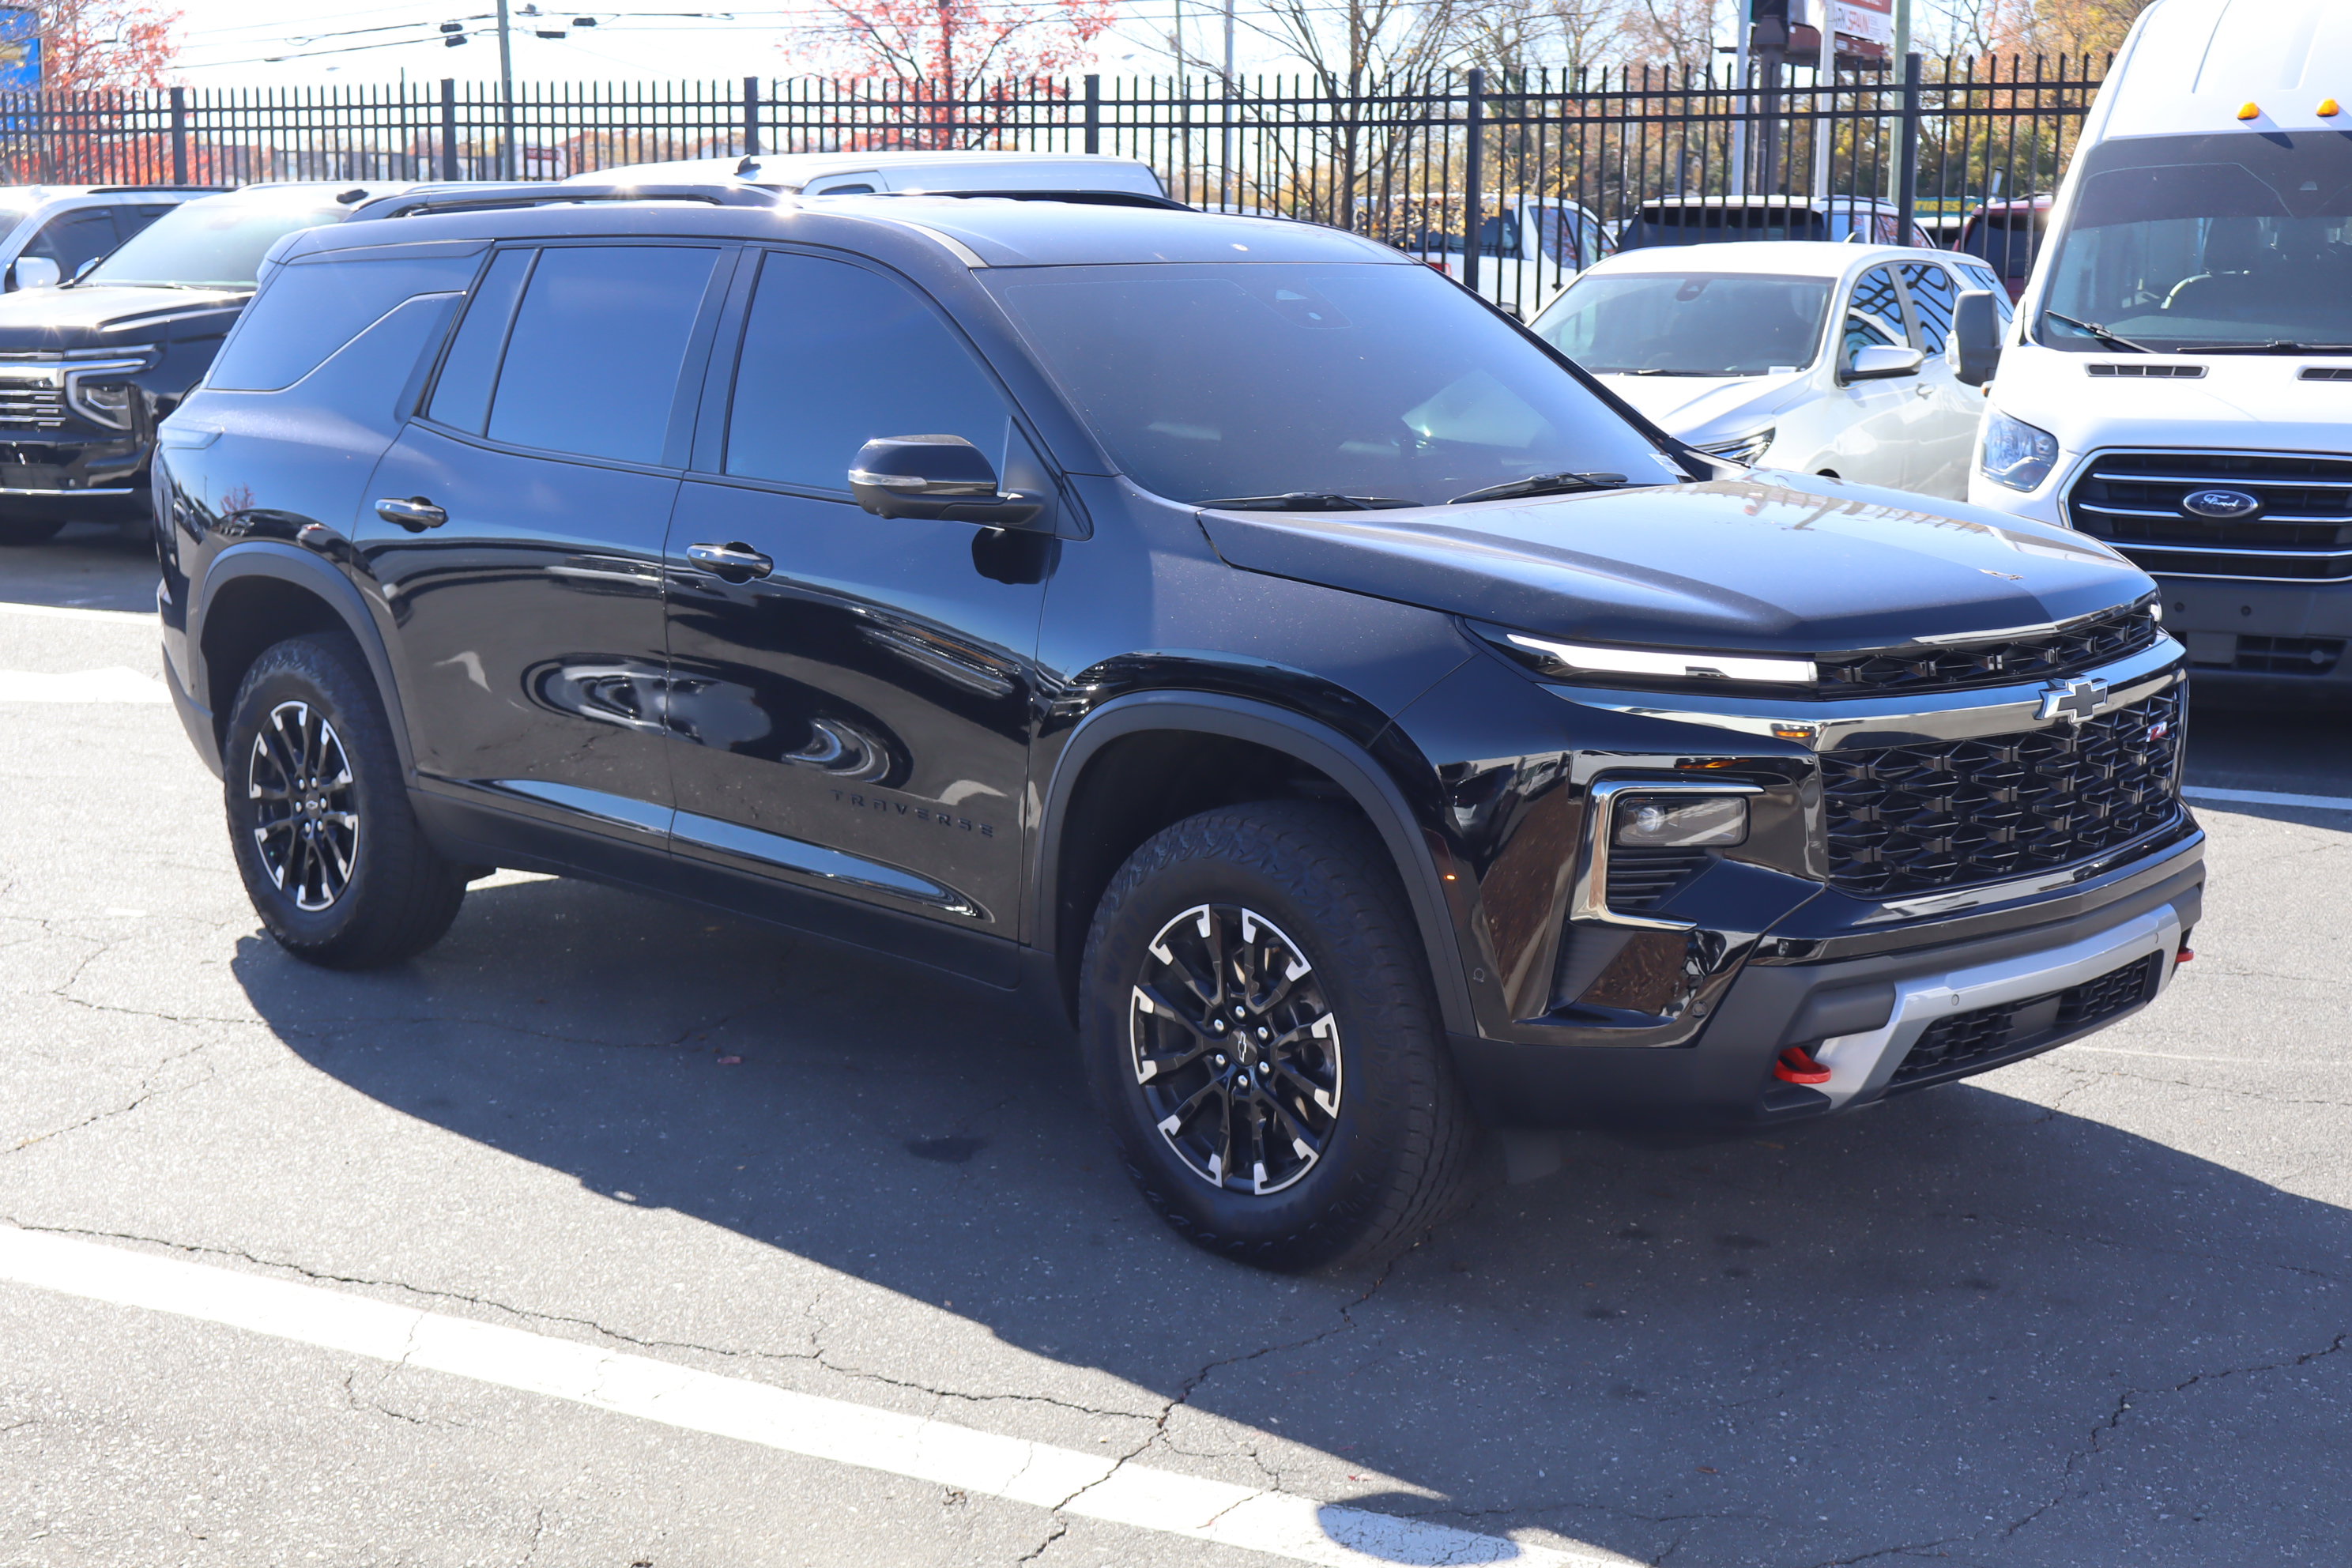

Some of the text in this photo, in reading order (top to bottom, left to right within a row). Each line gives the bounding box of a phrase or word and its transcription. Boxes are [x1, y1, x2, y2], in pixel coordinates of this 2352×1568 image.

[1913, 200, 1962, 212] TIRES
[2200, 493, 2240, 511] Ford
[831, 790, 994, 838] TRAVERSE
